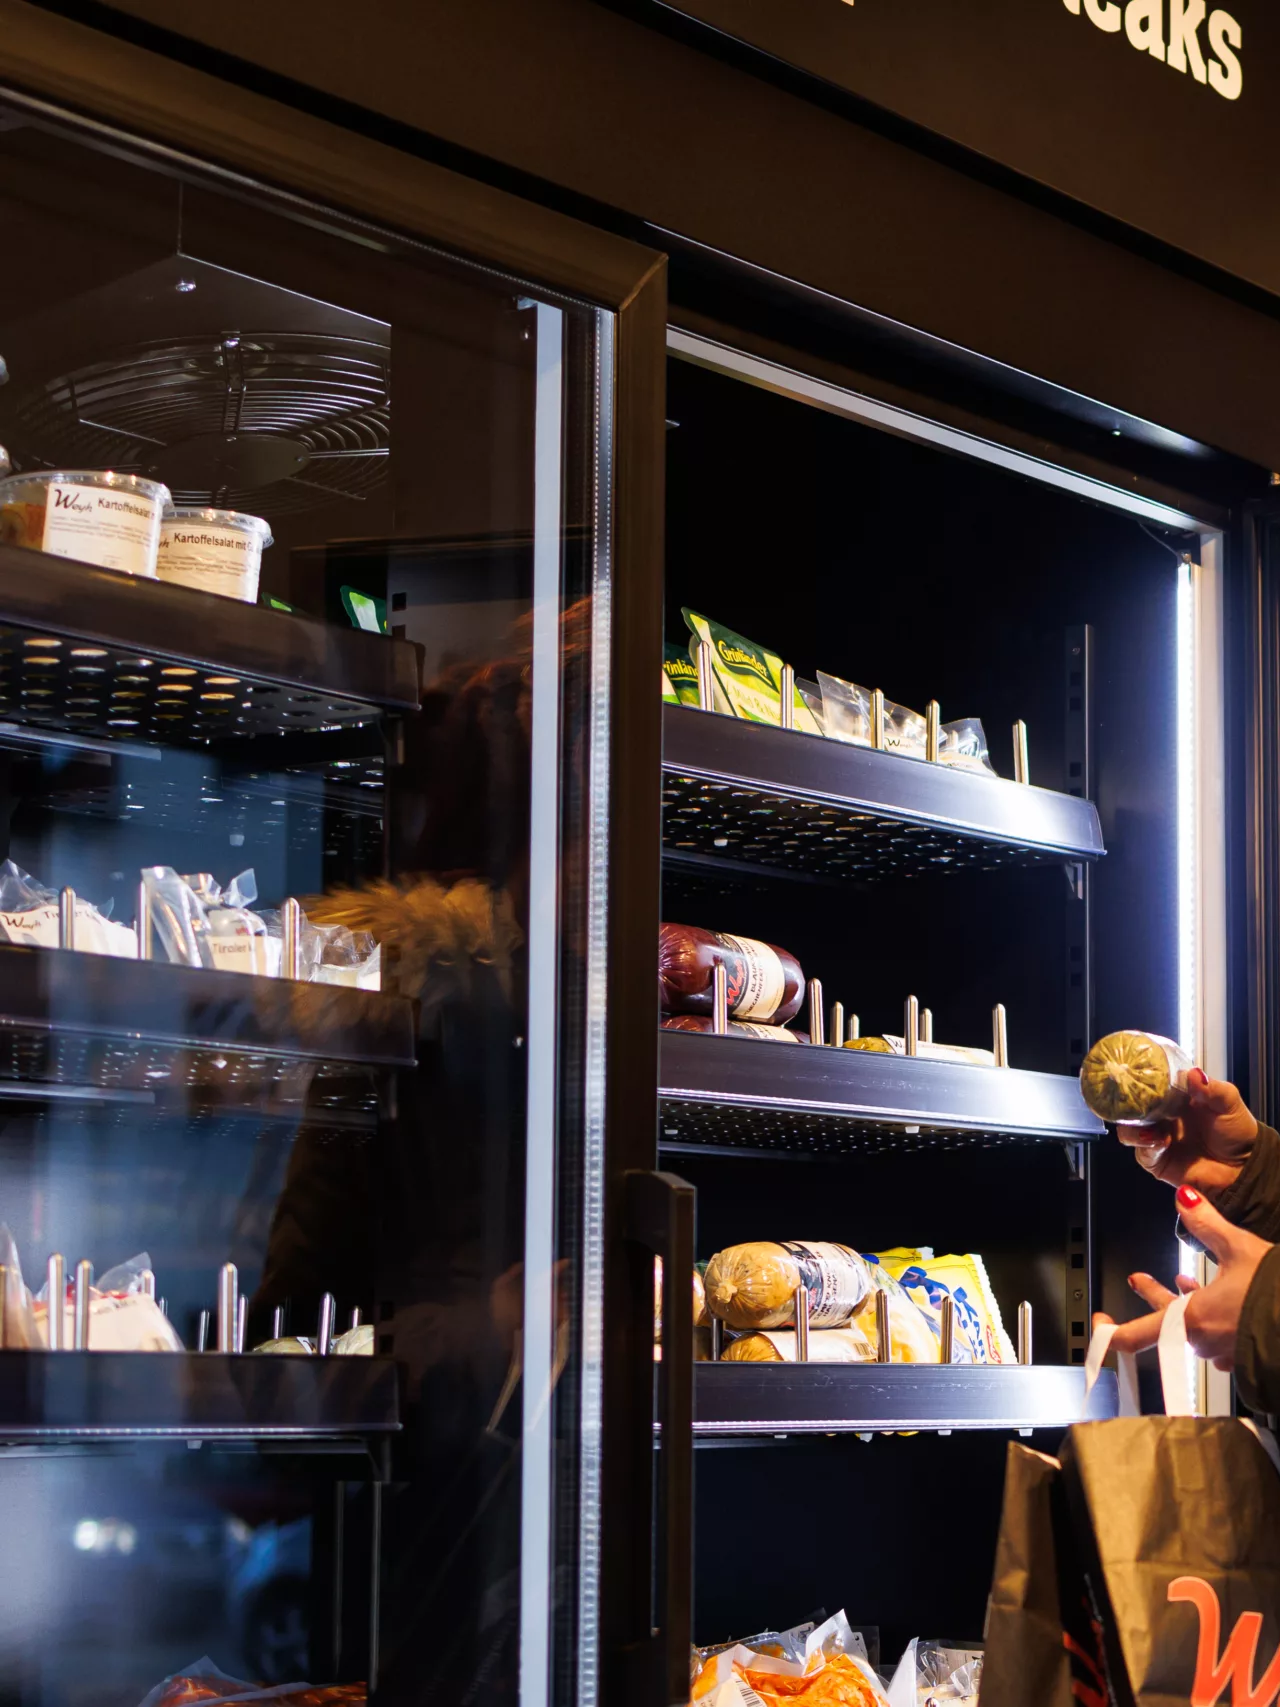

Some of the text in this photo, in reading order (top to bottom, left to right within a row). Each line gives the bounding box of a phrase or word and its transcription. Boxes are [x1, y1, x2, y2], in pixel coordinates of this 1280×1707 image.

[1062, 0, 1243, 100] aks
[174, 532, 234, 549] Kartoffelsalat
[717, 640, 768, 677] Grünländer
